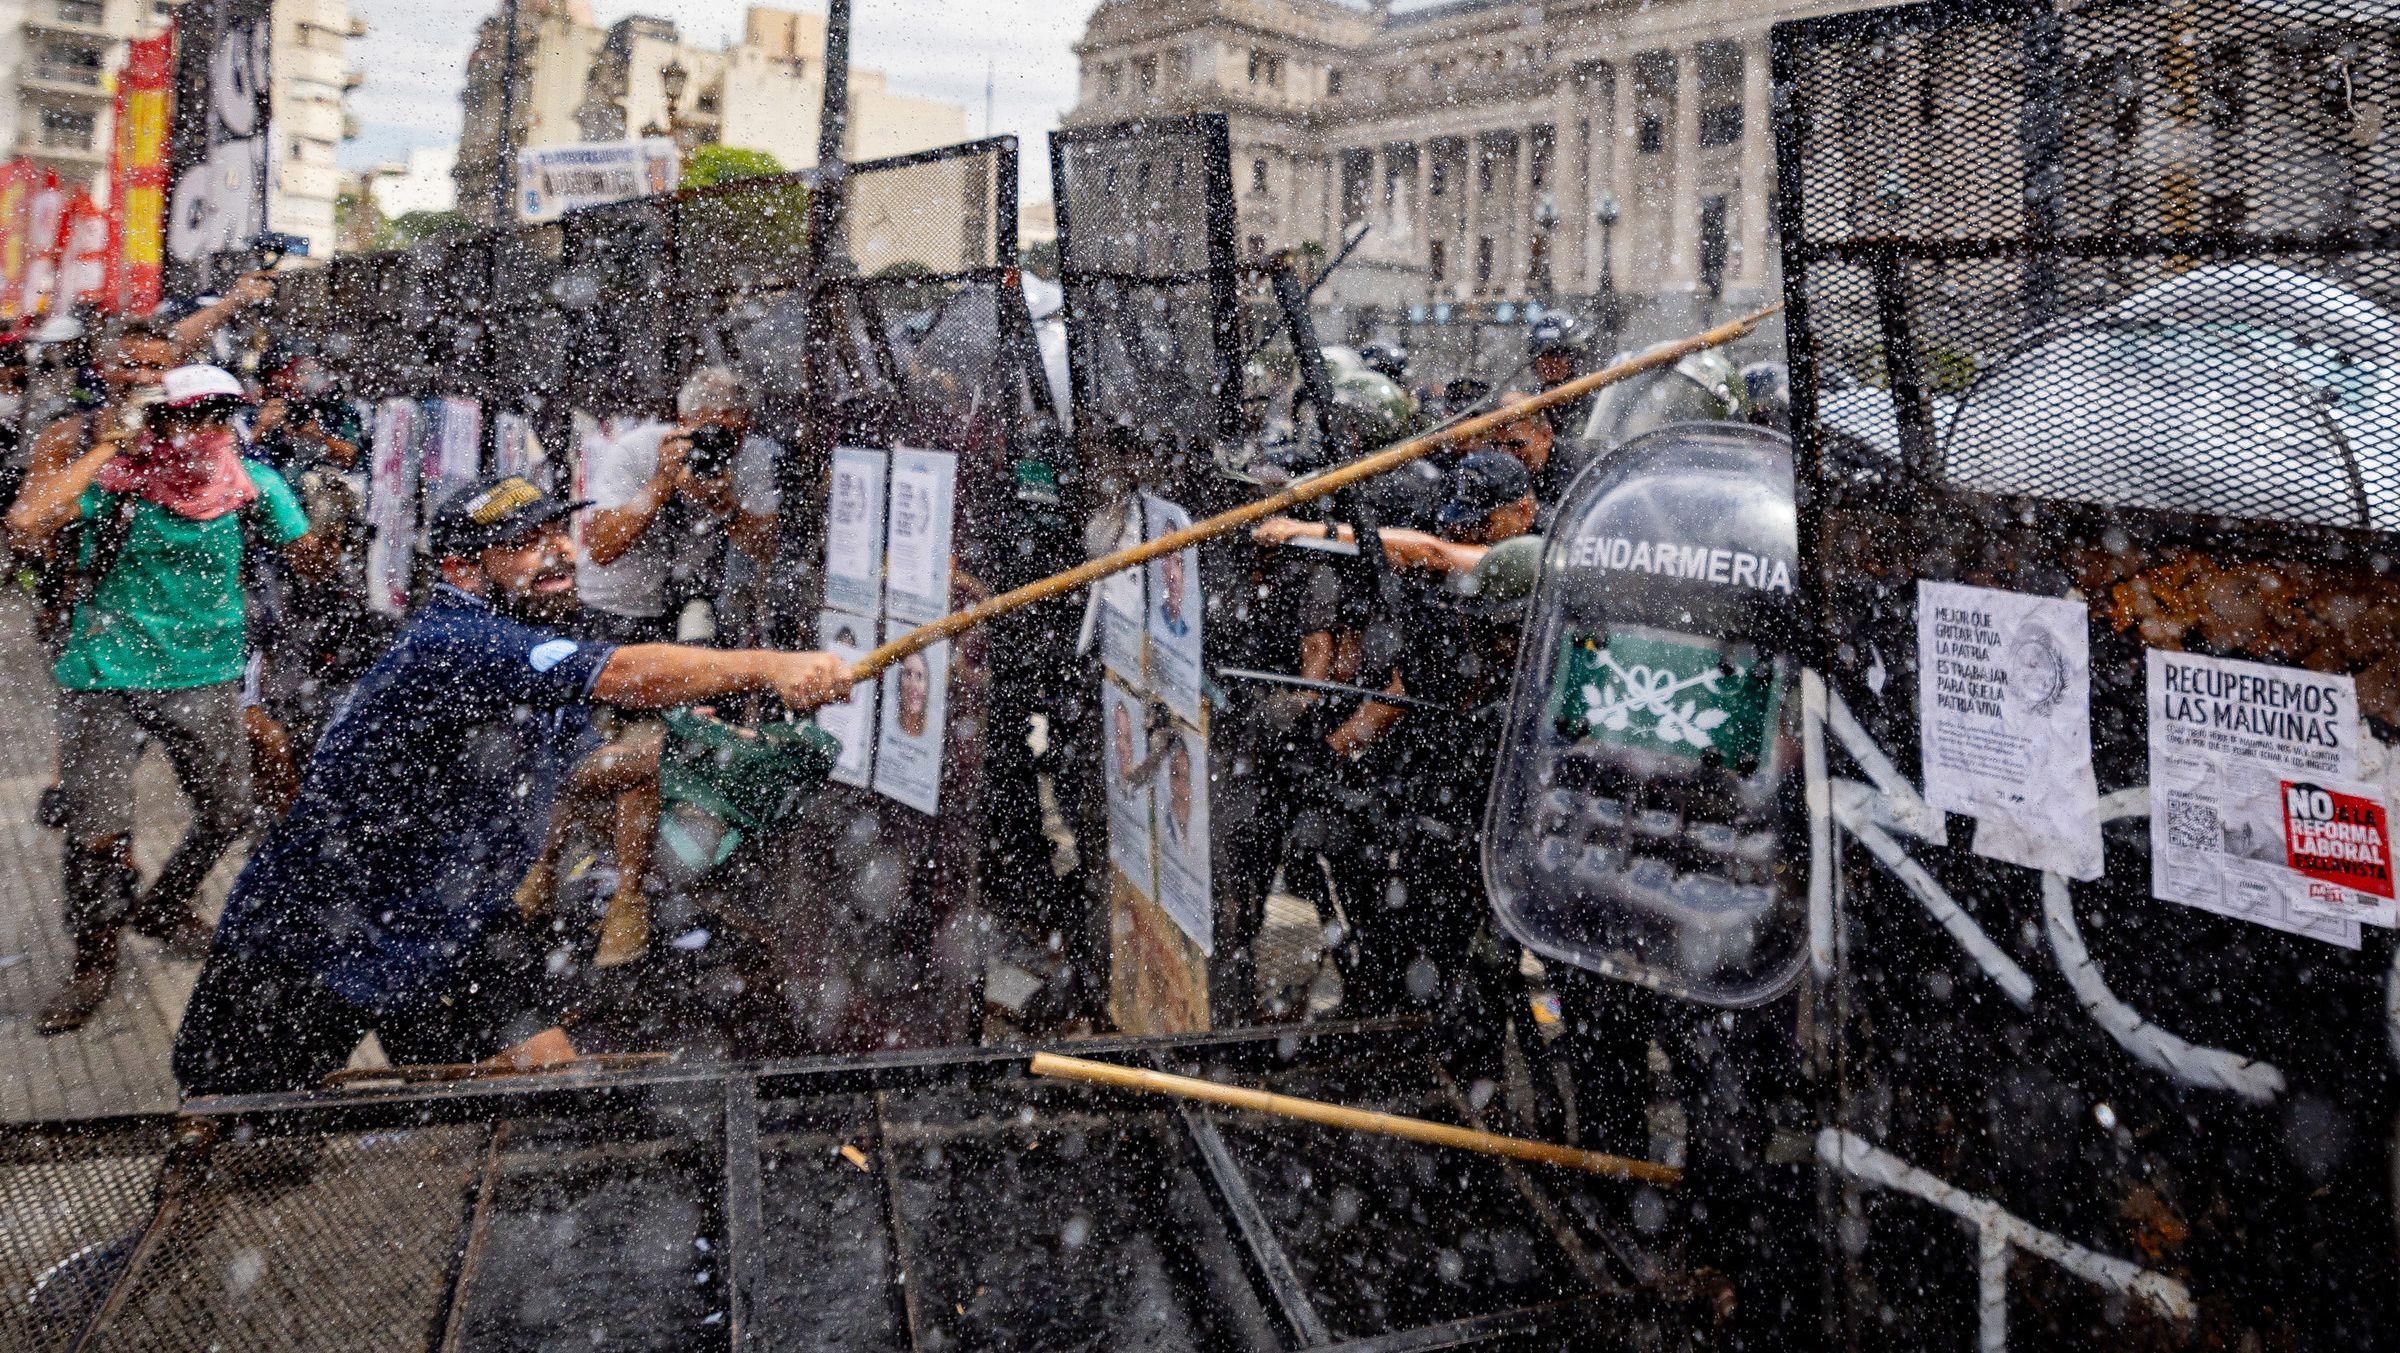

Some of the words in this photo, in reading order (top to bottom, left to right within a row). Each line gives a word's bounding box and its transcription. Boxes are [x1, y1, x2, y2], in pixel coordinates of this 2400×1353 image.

[1936, 607, 1969, 624] MEJOR
[1972, 612, 1992, 628] QUE
[1936, 624, 1973, 641] GRITAR
[1975, 630, 2002, 646] VIVA
[1936, 640, 1949, 655] LA
[1952, 643, 1990, 662] PATRIA
[1937, 659, 1949, 674] ES
[1951, 661, 2008, 685] TRABAJAR
[1937, 676, 1965, 693] PARA
[1967, 682, 1987, 699] QUE
[1989, 686, 2005, 702] LA
[2165, 663, 2338, 716] RECUPEREMOS
[1937, 693, 1975, 713] PATRIA
[1976, 700, 2003, 720] VIVA
[2165, 694, 2208, 724] LAS
[2213, 702, 2339, 748] MALVINAS
[2286, 788, 2334, 821] NO
[2338, 806, 2349, 822] A
[2353, 809, 2377, 827] LA
[2292, 820, 2382, 846] REFORMA
[2293, 835, 2385, 865] LABORAL
[2294, 853, 2387, 881] ESCLAVISTA
